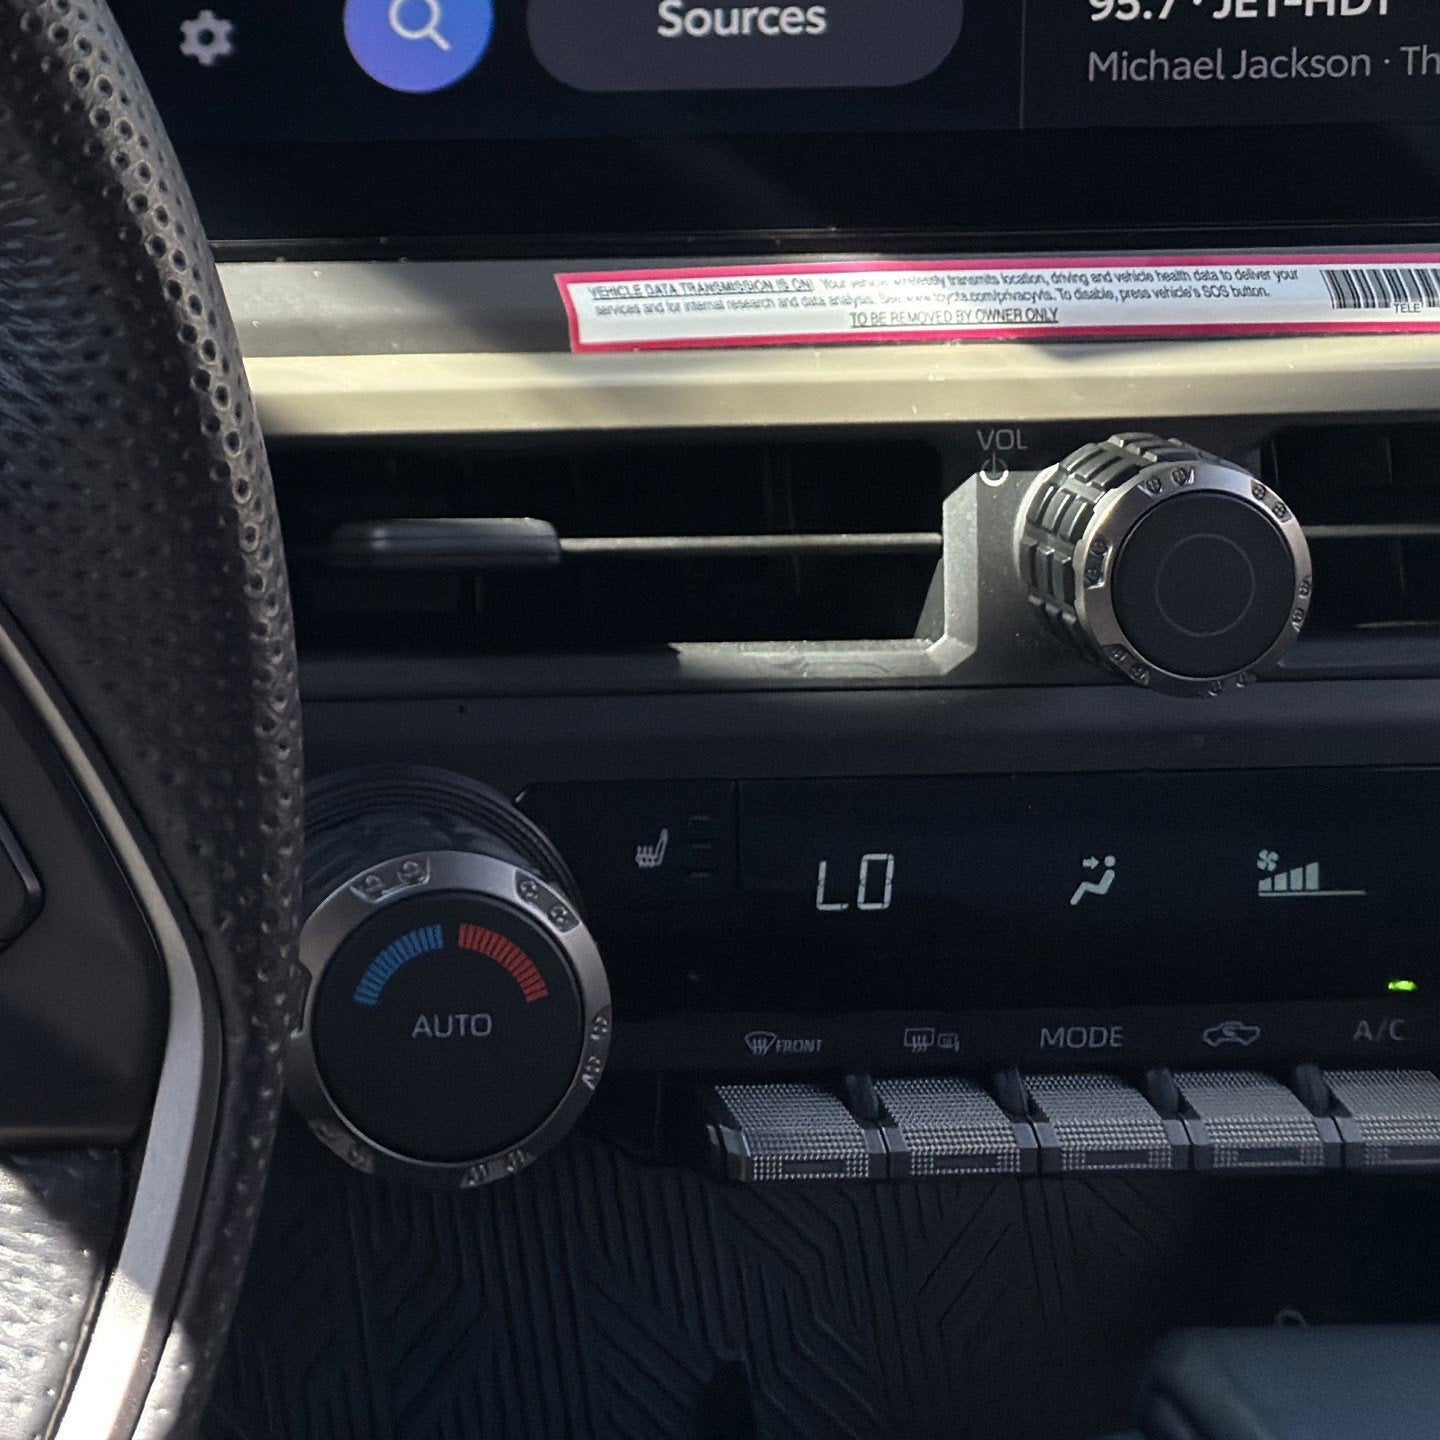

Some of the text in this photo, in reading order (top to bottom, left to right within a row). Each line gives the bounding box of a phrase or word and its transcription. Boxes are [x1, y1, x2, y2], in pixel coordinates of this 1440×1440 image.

[1087, 44, 1440, 82] Michael Jackson Th
[588, 283, 641, 300] VEHICLE
[645, 282, 676, 298] DATA
[680, 279, 772, 297] TRANSMISSION
[1051, 271, 1088, 285] driving
[1090, 271, 1110, 283] and
[1193, 269, 1218, 281] data
[1235, 268, 1270, 280] deliver
[1273, 269, 1299, 283] your
[1058, 288, 1072, 300] To
[1121, 288, 1151, 302] press
[1203, 285, 1230, 298] SOS
[850, 307, 1058, 325] TO BE REMOVED BY OWNER ONLY
[1393, 303, 1421, 314] TELE
[976, 428, 1029, 452] VOL
[411, 1013, 493, 1039] AUTO
[1039, 1026, 1123, 1050] MODE
[1353, 1018, 1406, 1043] A/C
[774, 1037, 822, 1054] FRONT
